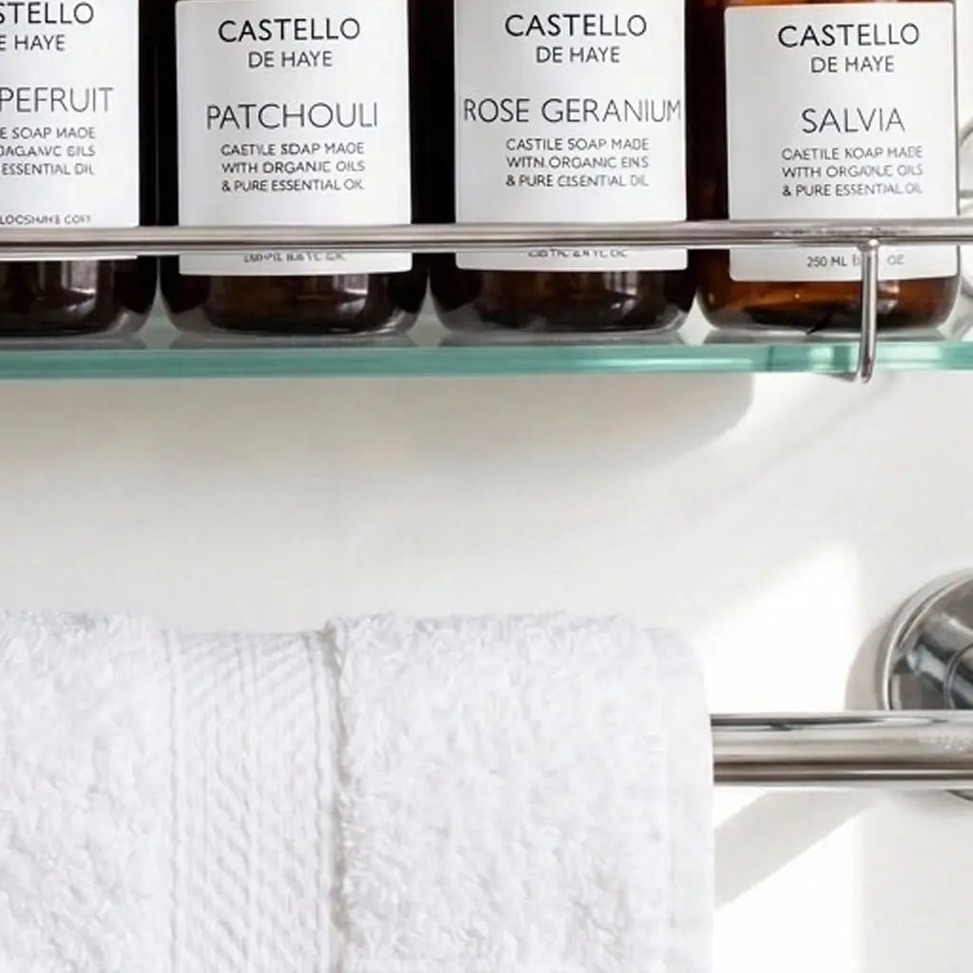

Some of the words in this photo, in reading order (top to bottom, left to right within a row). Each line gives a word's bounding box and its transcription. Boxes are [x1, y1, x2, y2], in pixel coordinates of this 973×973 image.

[218, 18, 360, 43] CASTELLO
[505, 14, 646, 37] CASTELLO
[15, 34, 64, 51] HAYE
[778, 23, 919, 48] CASTELLO
[249, 51, 274, 68] DE
[281, 51, 331, 67] HAYE
[536, 46, 563, 63] DE
[570, 46, 619, 63] HAYE
[811, 57, 837, 73] DE
[845, 55, 893, 72] HAYE
[207, 103, 377, 130] PATCHOULI
[464, 98, 530, 123] ROSE
[541, 98, 680, 123] GERANIUM
[802, 108, 905, 133] SALVIA
[12, 127, 52, 139] SOAP
[505, 138, 563, 151] CASTILE
[568, 138, 607, 151] SOAP
[1, 163, 71, 175] ESSENTIAL
[221, 162, 258, 173] WITH
[336, 160, 365, 172] OILS
[222, 180, 231, 192] &
[234, 180, 268, 192] PURE
[271, 179, 340, 192] ESSENTIAL
[506, 175, 515, 186] &
[519, 174, 553, 187] PURE
[782, 185, 791, 196] &
[796, 184, 831, 197] PURE
